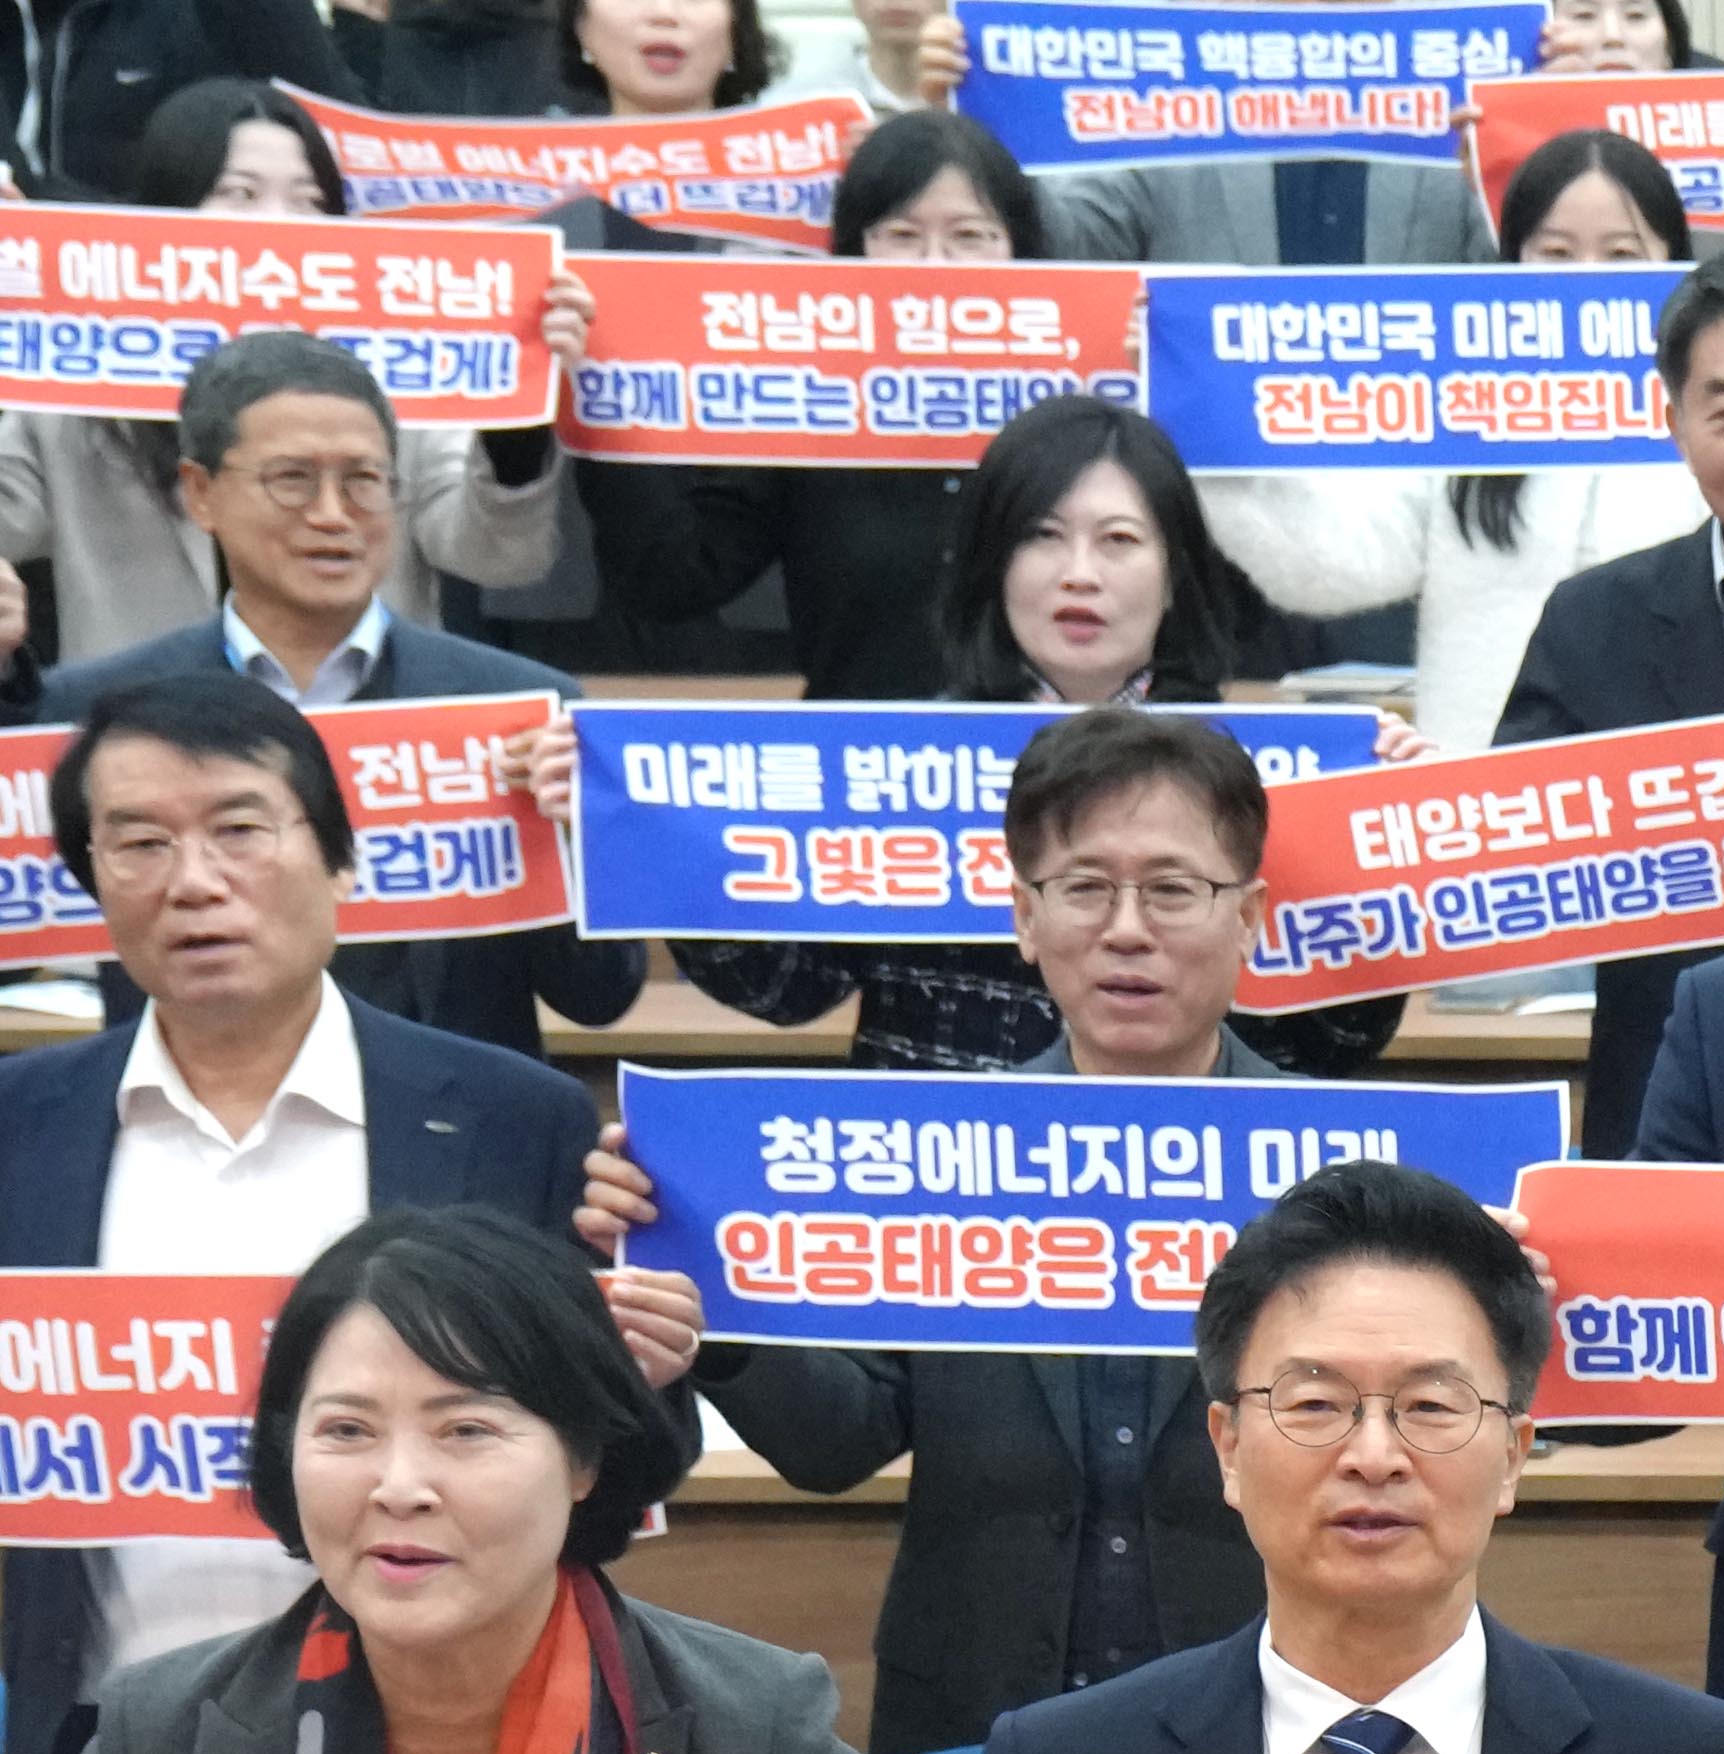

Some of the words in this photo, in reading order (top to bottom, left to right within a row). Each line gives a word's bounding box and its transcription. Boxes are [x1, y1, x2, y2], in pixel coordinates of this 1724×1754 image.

[981, 25, 1185, 78] 대한민국
[1198, 31, 1399, 81] 핵융합의
[1410, 31, 1525, 81] 중심,
[722, 122, 837, 174] 전남!
[1068, 91, 1216, 139] 전남이
[1232, 89, 1448, 136] 해냅니다!
[58, 239, 355, 310] 에너지수도
[375, 256, 514, 318] 전남!
[701, 292, 878, 353] 전남의
[891, 295, 1081, 360] 힘으로,
[1212, 301, 1435, 362] 대한민국
[1454, 301, 1563, 359] 미래
[577, 367, 678, 424] 함께
[698, 371, 853, 429] 만드는
[1260, 380, 1429, 436] 전남이
[1445, 378, 1668, 436] 책임집니
[349, 736, 508, 809] 전남!
[624, 742, 823, 811] 미래를
[1349, 775, 1612, 871] 태양보다
[356, 824, 517, 895] 겁게!
[726, 831, 798, 896] 그
[812, 832, 946, 899] 빛은
[1252, 895, 1421, 972] 나주가
[1435, 846, 1718, 948] 인공태양을
[758, 1116, 1224, 1200] 청정에너지의
[723, 1220, 1105, 1301] 인공태양은
[0, 1319, 237, 1396] 에너지
[1567, 1304, 1709, 1376] 함께
